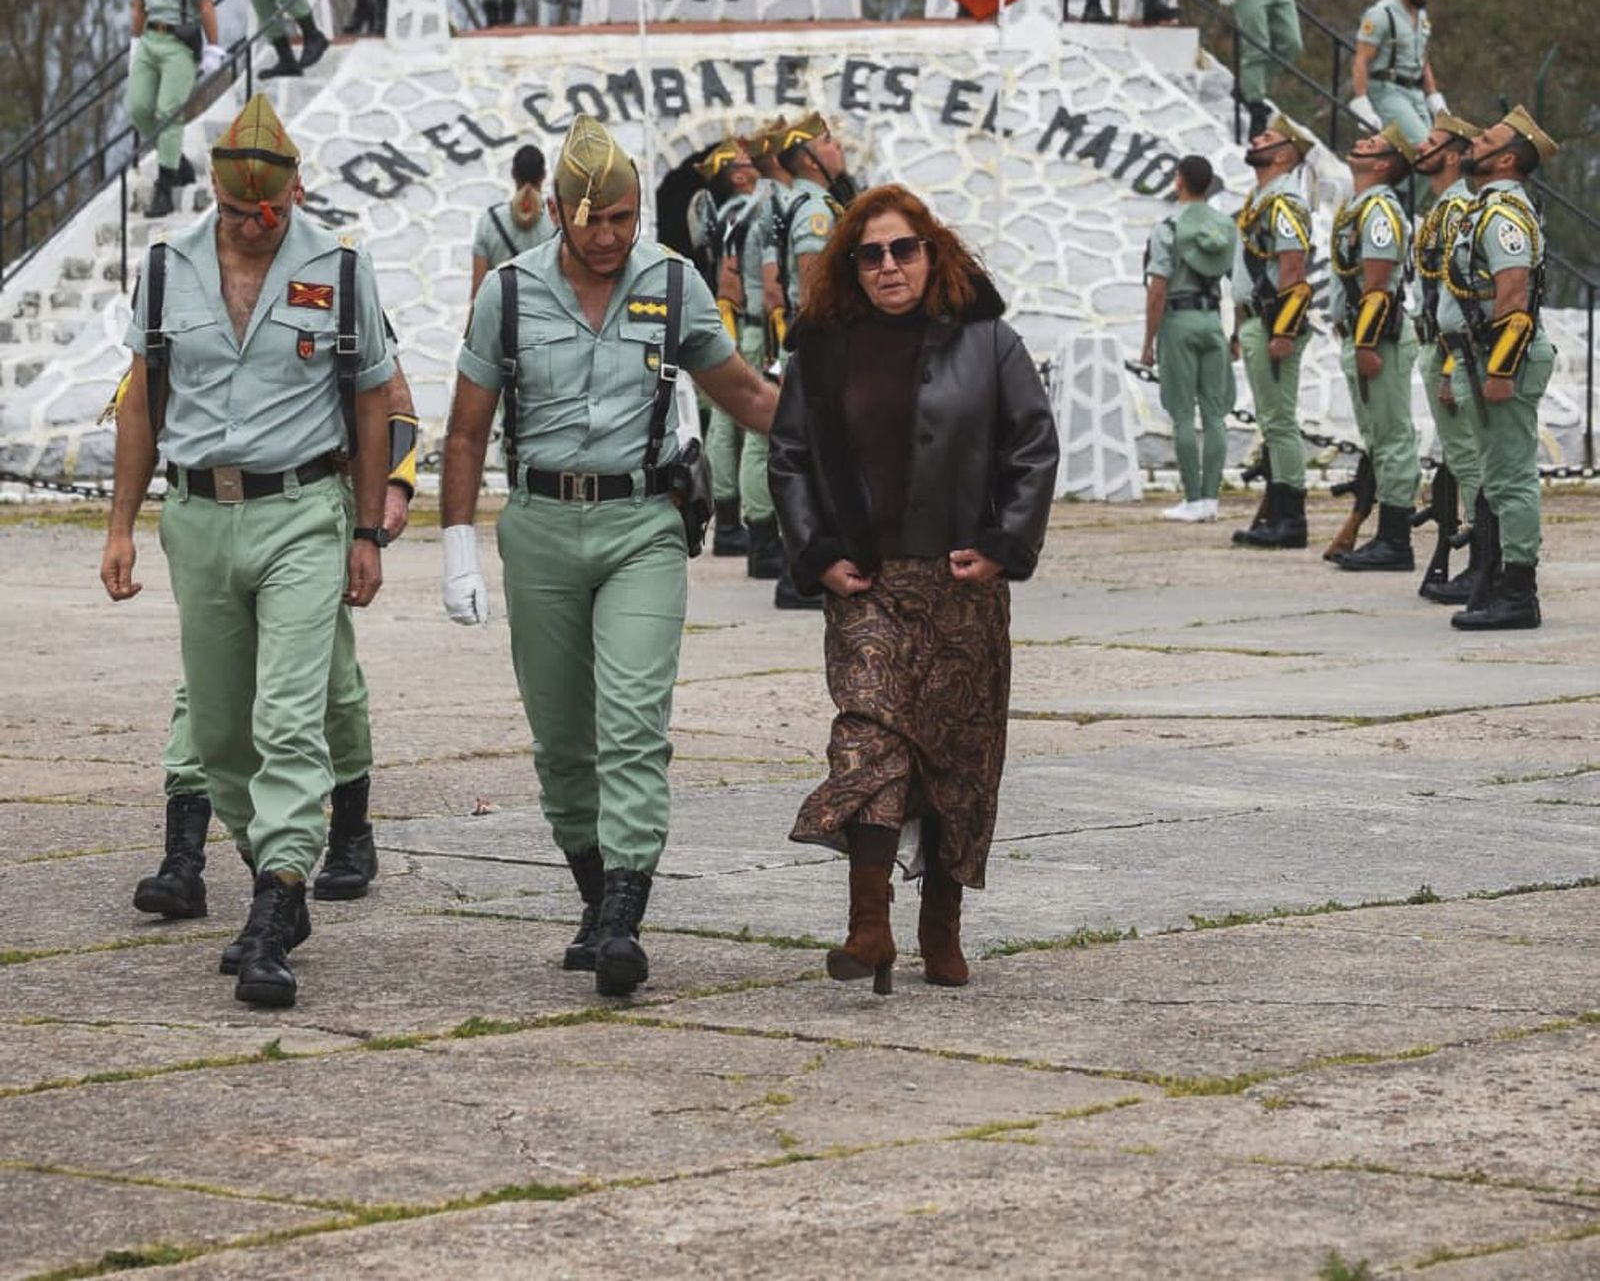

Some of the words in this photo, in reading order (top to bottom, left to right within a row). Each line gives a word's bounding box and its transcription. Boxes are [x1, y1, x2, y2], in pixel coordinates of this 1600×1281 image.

[340, 141, 430, 199] EN
[422, 114, 517, 166] EL
[524, 55, 809, 133] COMBATE
[840, 60, 919, 112] ES
